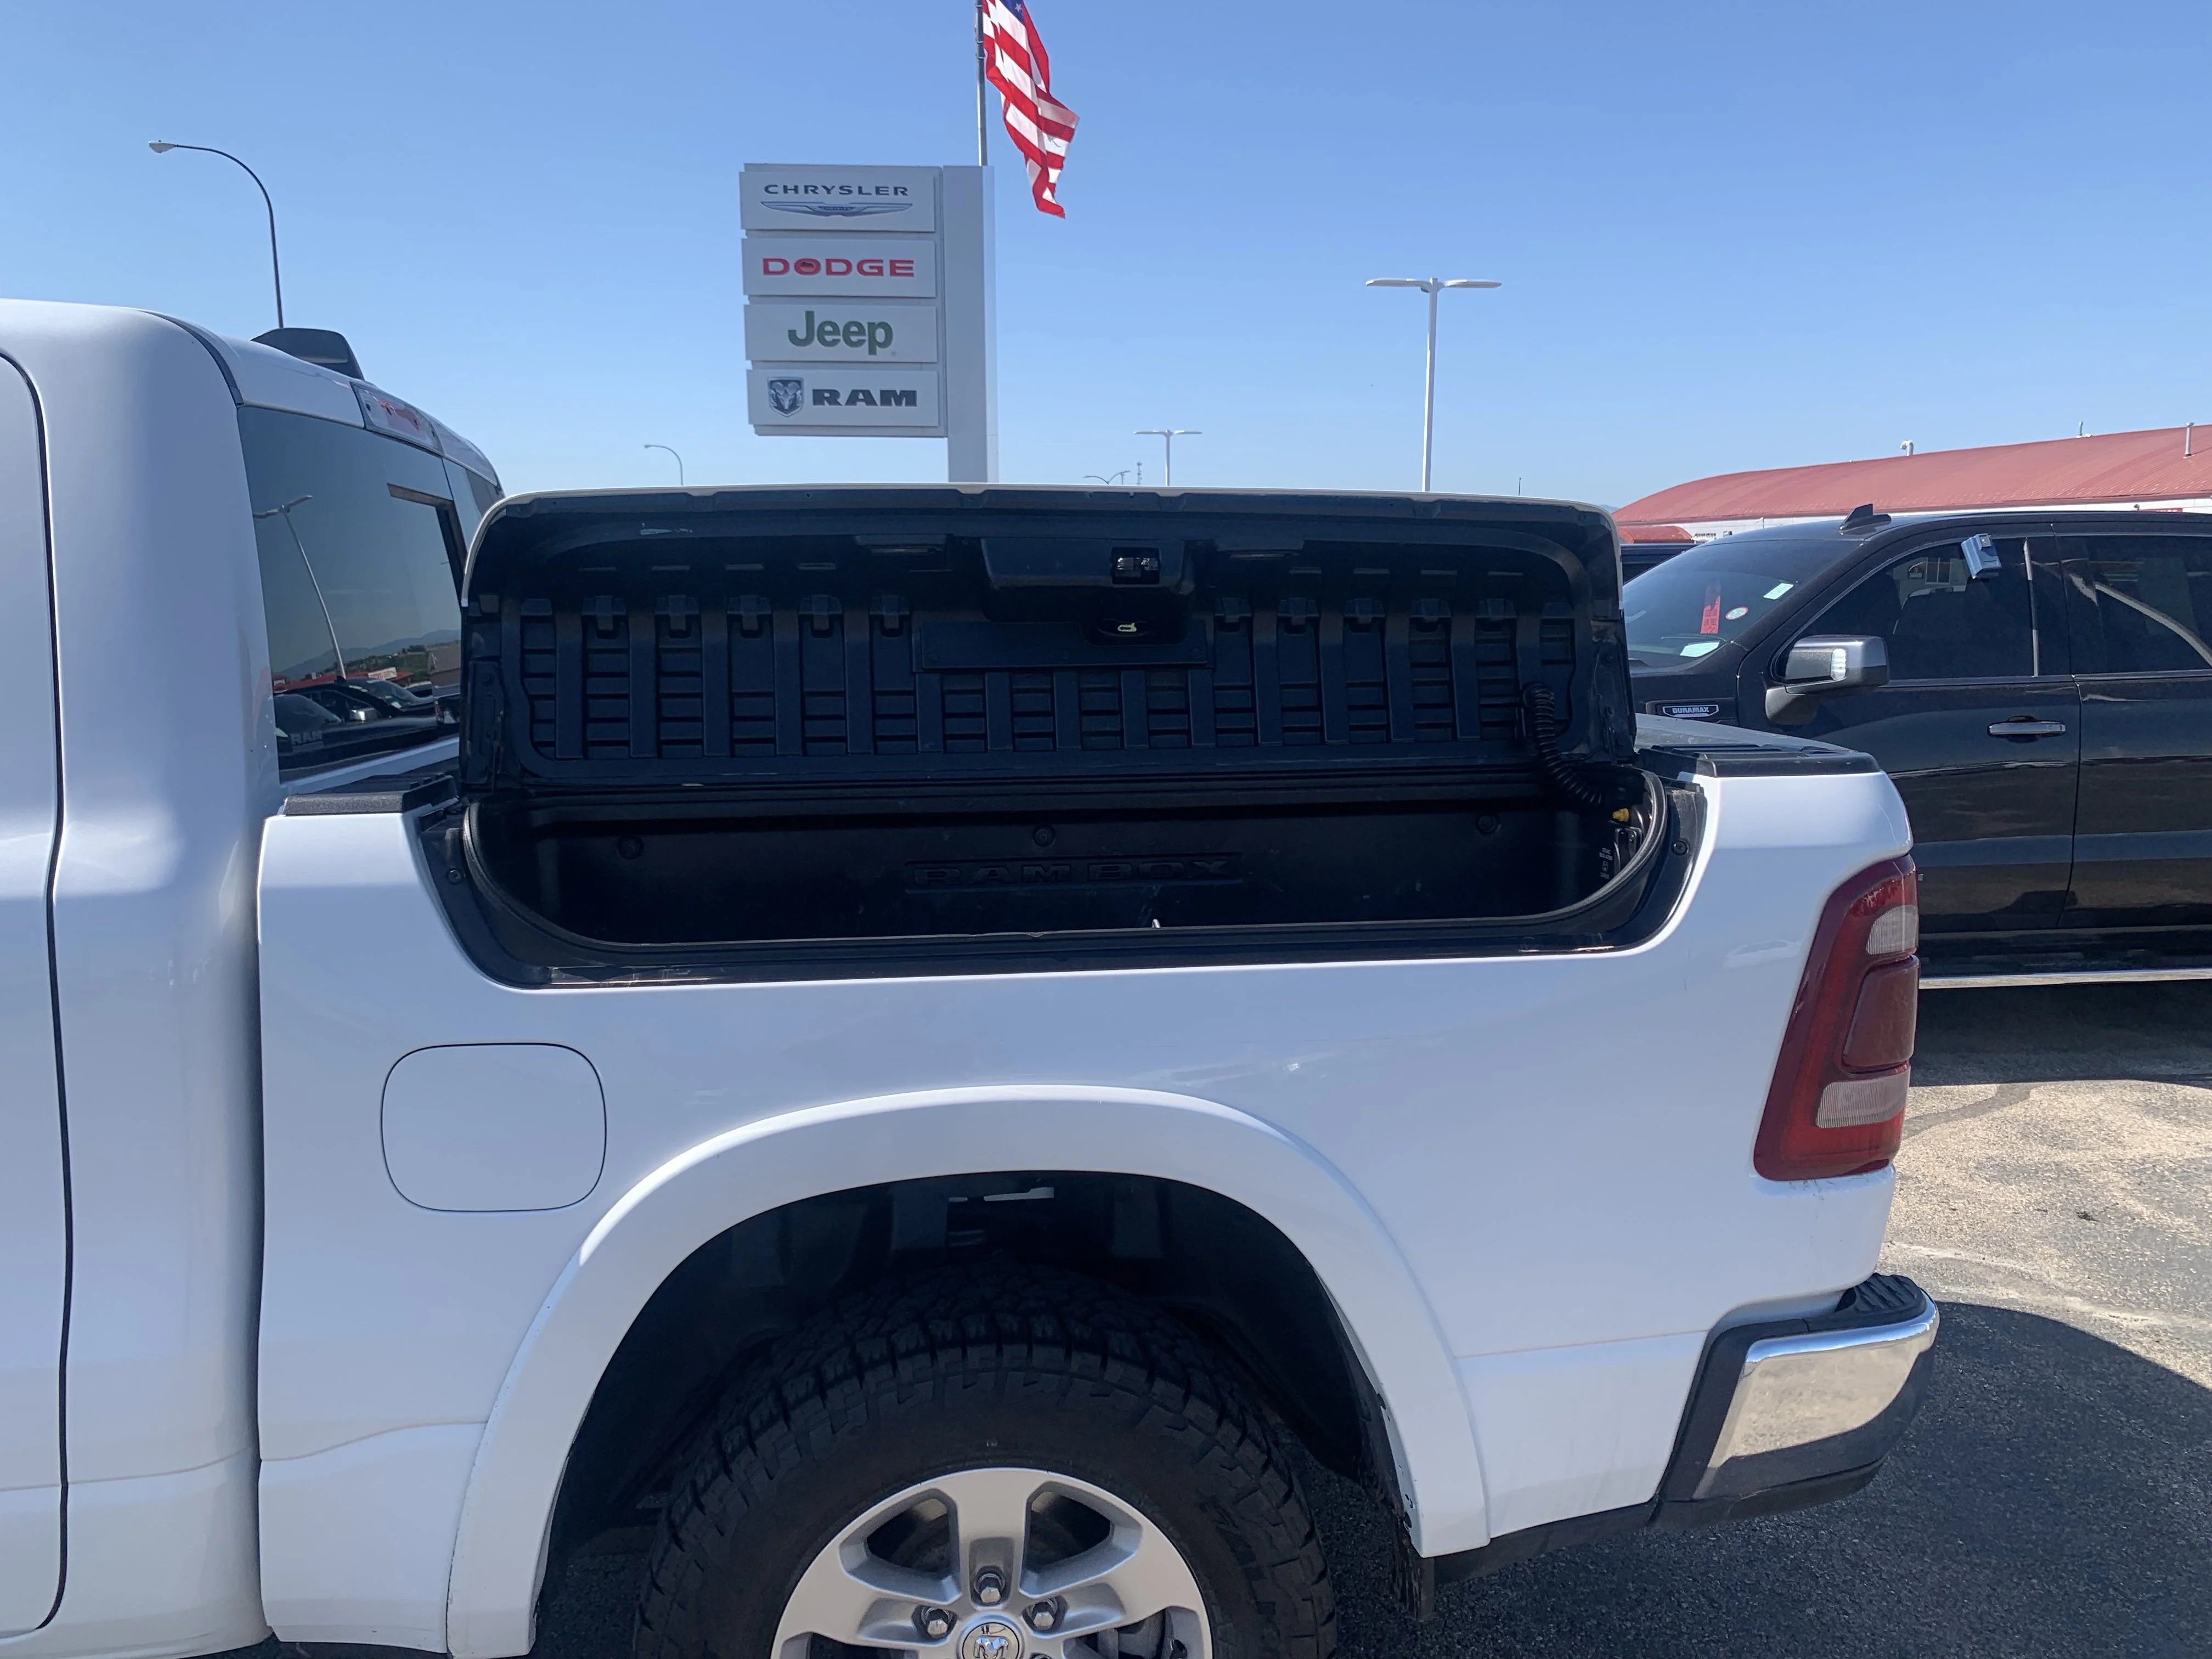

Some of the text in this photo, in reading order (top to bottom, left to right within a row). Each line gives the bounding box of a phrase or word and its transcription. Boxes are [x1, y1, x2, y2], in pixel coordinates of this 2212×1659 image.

[764, 184, 909, 196] CHRYSLER
[763, 258, 915, 277] DODGE
[788, 311, 893, 356] Jeep
[812, 389, 917, 407] RAM
[913, 860, 1229, 885] RAM BOX
